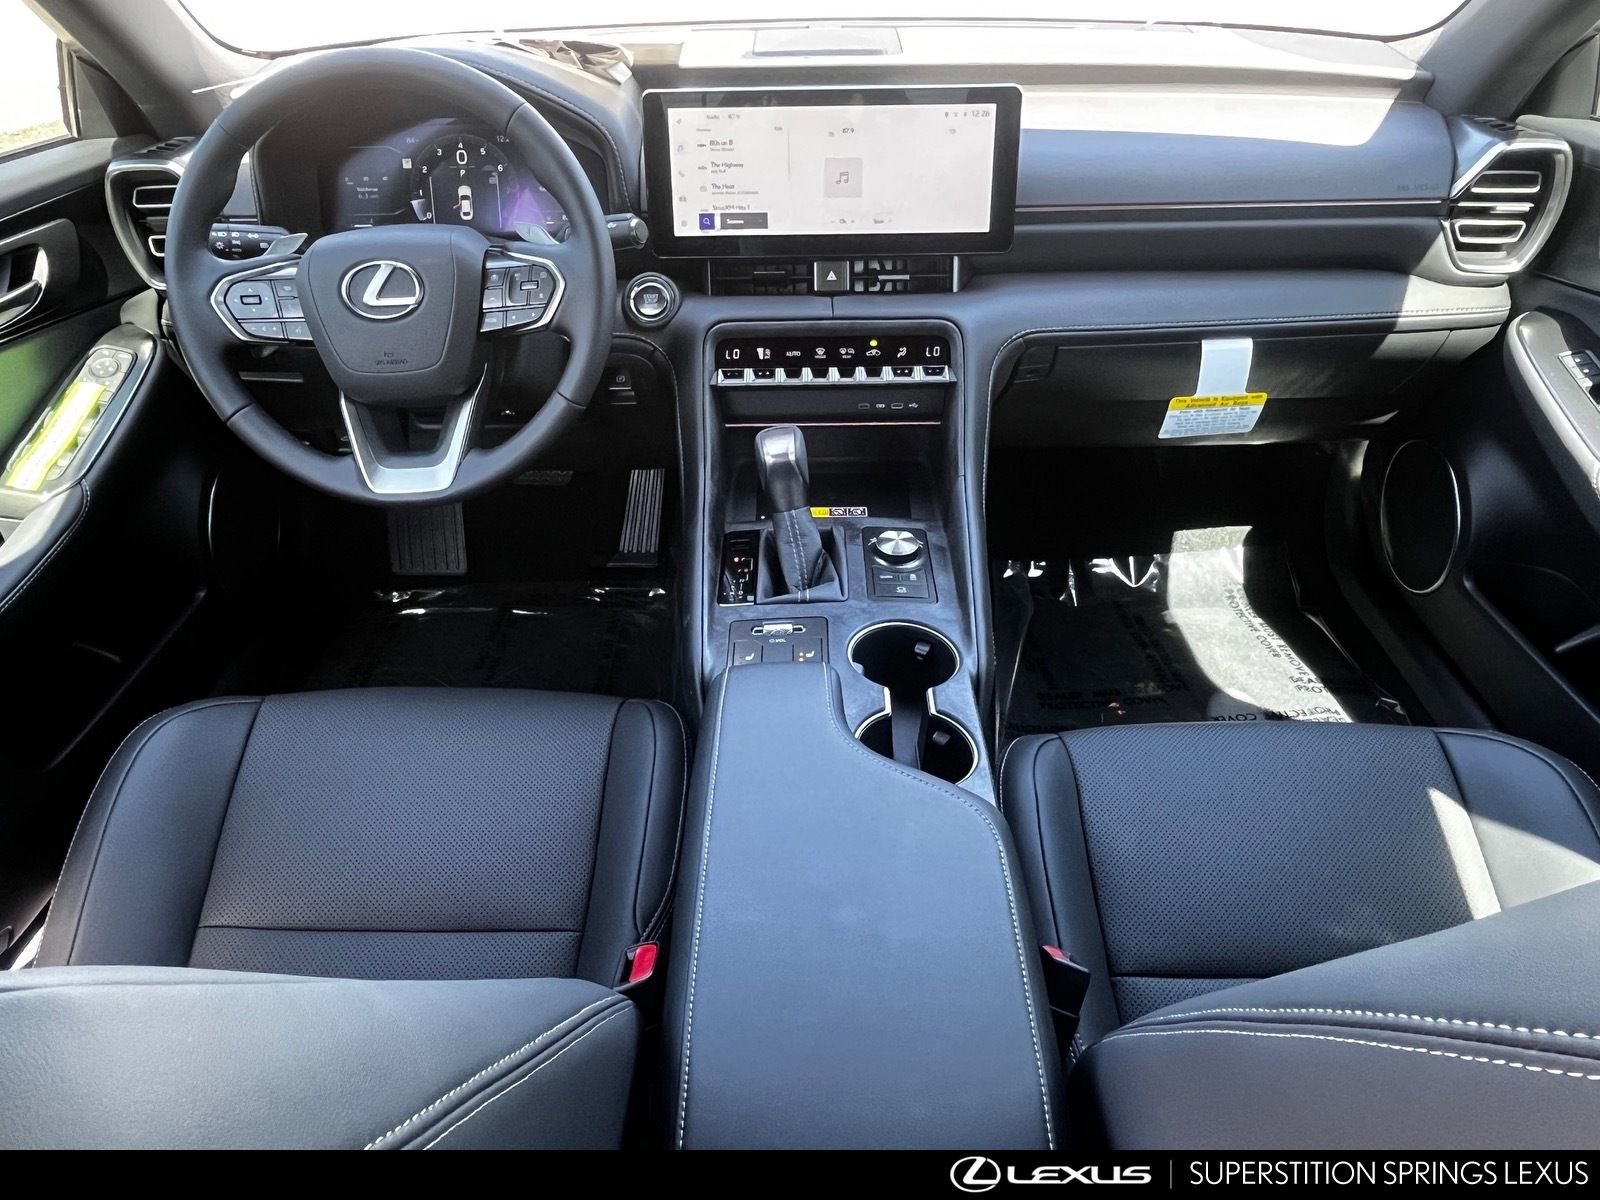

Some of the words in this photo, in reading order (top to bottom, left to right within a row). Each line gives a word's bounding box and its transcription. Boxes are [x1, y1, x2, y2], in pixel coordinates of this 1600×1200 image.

[457, 141, 464, 149] 4
[437, 148, 443, 156] 3
[481, 147, 487, 155] 5
[456, 149, 468, 165] 0
[422, 165, 428, 173] 2
